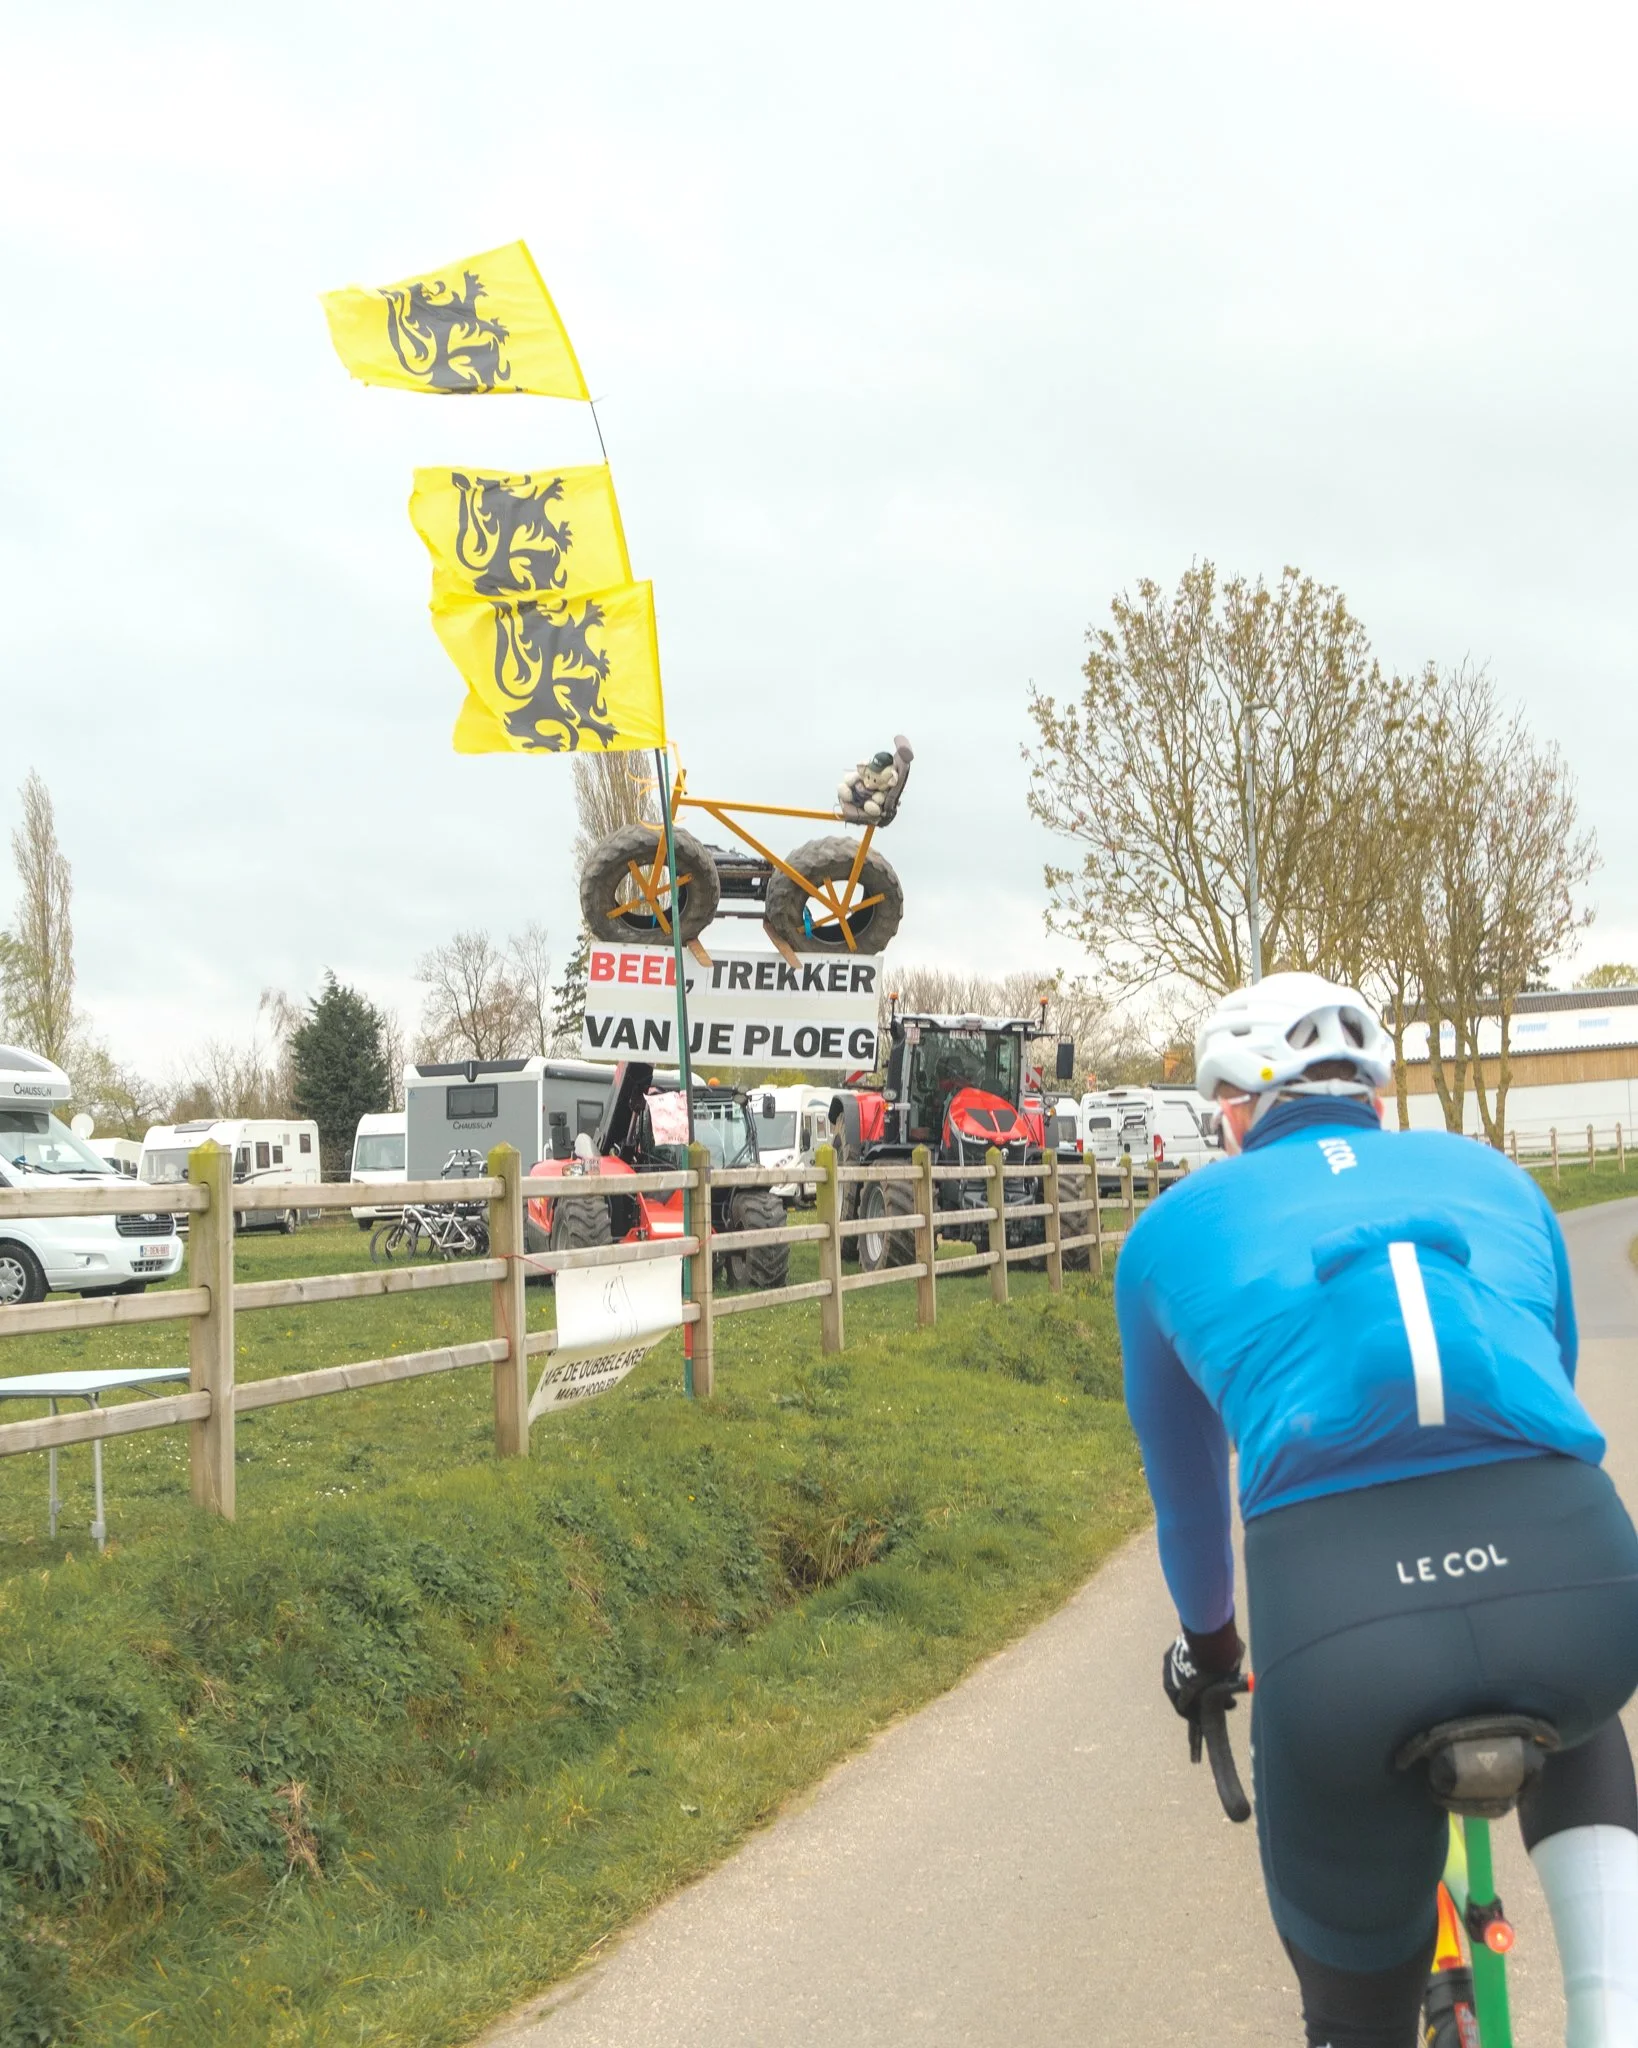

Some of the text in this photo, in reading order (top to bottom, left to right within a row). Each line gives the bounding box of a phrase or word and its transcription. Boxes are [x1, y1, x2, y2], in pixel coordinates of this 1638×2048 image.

[711, 960, 876, 993] TREKKER
[585, 1015, 875, 1060] VAN JE PLOEG
[562, 1361, 582, 1382] DE
[579, 1351, 626, 1380] DUBBELE
[621, 1345, 655, 1368] ARE
[1396, 1543, 1508, 1584] LE COL
